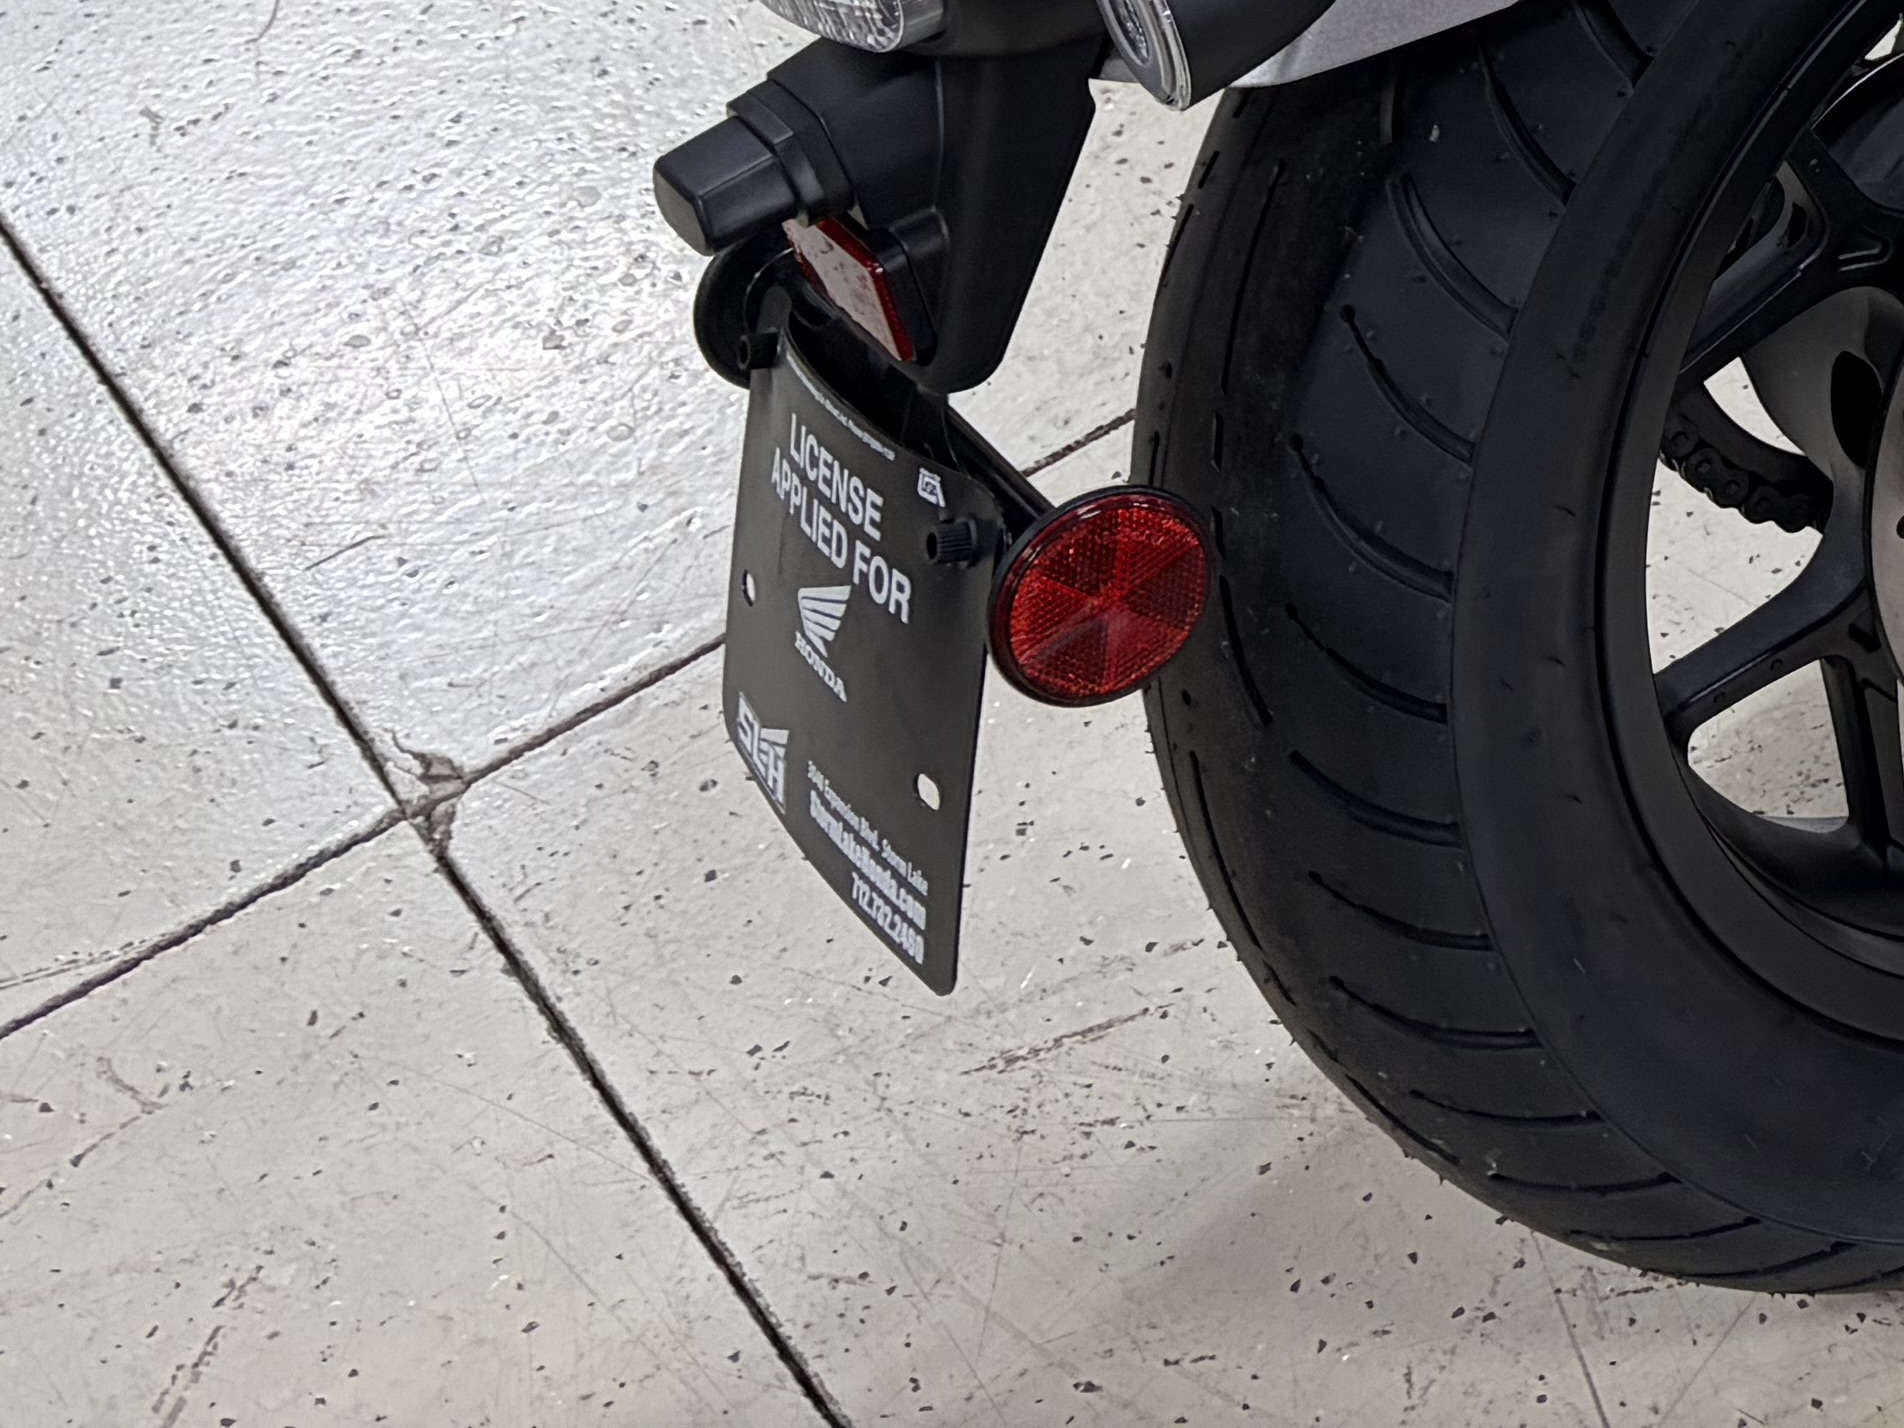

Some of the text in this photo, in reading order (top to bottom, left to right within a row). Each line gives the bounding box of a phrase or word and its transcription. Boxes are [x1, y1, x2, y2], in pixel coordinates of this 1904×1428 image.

[789, 412, 884, 542] LICENSE
[771, 447, 848, 569] APPLIED
[853, 540, 911, 624] FOR
[794, 631, 848, 702] HONDA
[737, 694, 786, 806] SLH
[881, 839, 907, 877] Storm
[907, 862, 928, 896] Lake
